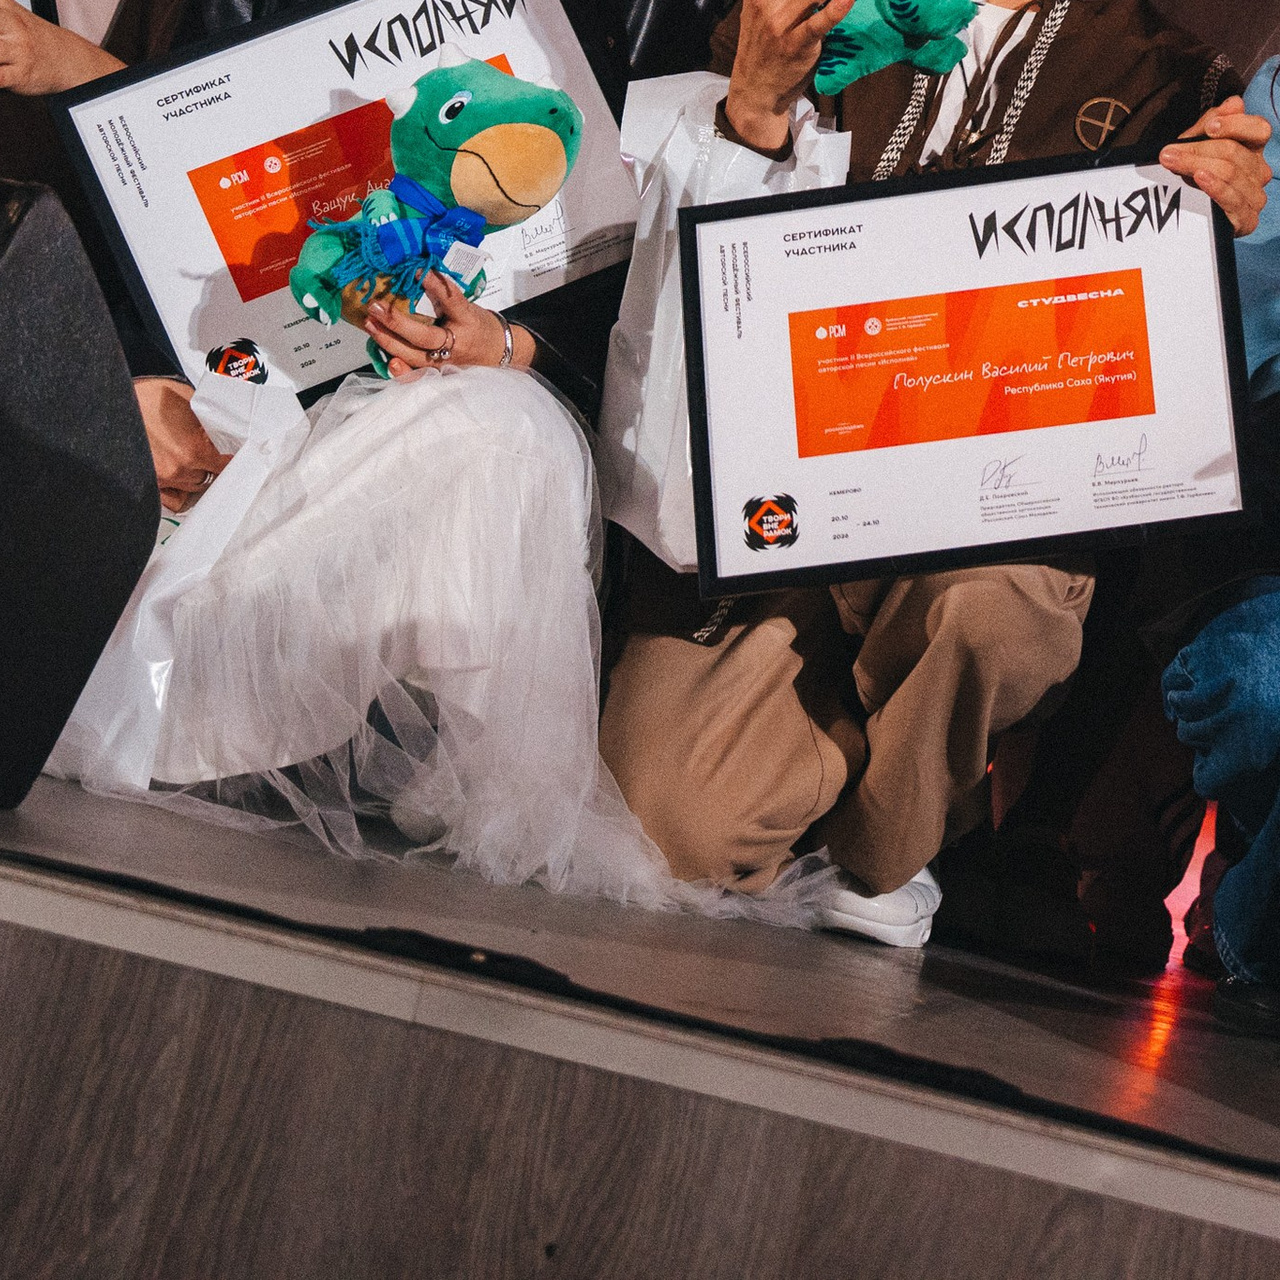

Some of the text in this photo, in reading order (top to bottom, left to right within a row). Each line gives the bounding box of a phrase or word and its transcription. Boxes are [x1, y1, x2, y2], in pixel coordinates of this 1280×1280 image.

[156, 73, 232, 108] СЕРТИФИКАТ
[163, 91, 232, 122] УЧАСТНИКА
[118, 115, 147, 171] ВСЕРОССИЙСКИЙ
[96, 123, 127, 186] АВТОРСКОЙ ПЕСНИ
[108, 119, 149, 208] МОЛОДЁЖНЫЙ ФЕСТИВАЛЬ
[230, 170, 250, 186] РСМ
[968, 185, 1182, 260] ИСПОЛНЯЙ
[783, 224, 864, 243] СЕРТИФИКАТ
[784, 241, 857, 258] УЧАСТНИКА
[742, 241, 752, 302] ВСЕРОССИЙСКИЙ
[1017, 288, 1125, 308] СТУДВЕСНА
[829, 324, 846, 338] РСМ
[293, 342, 310, 352] 20.10
[325, 339, 341, 349] 24.10
[227, 355, 256, 371] ТВОРИ
[230, 367, 247, 378] ВНЕ
[893, 350, 1135, 391] Полускин Василий Петрович
[1004, 371, 1137, 395] Республика Саха (Якутия)
[761, 514, 791, 522] ТВОРИ
[762, 522, 779, 530] ВНЕ
[763, 528, 793, 538] РАМОК
